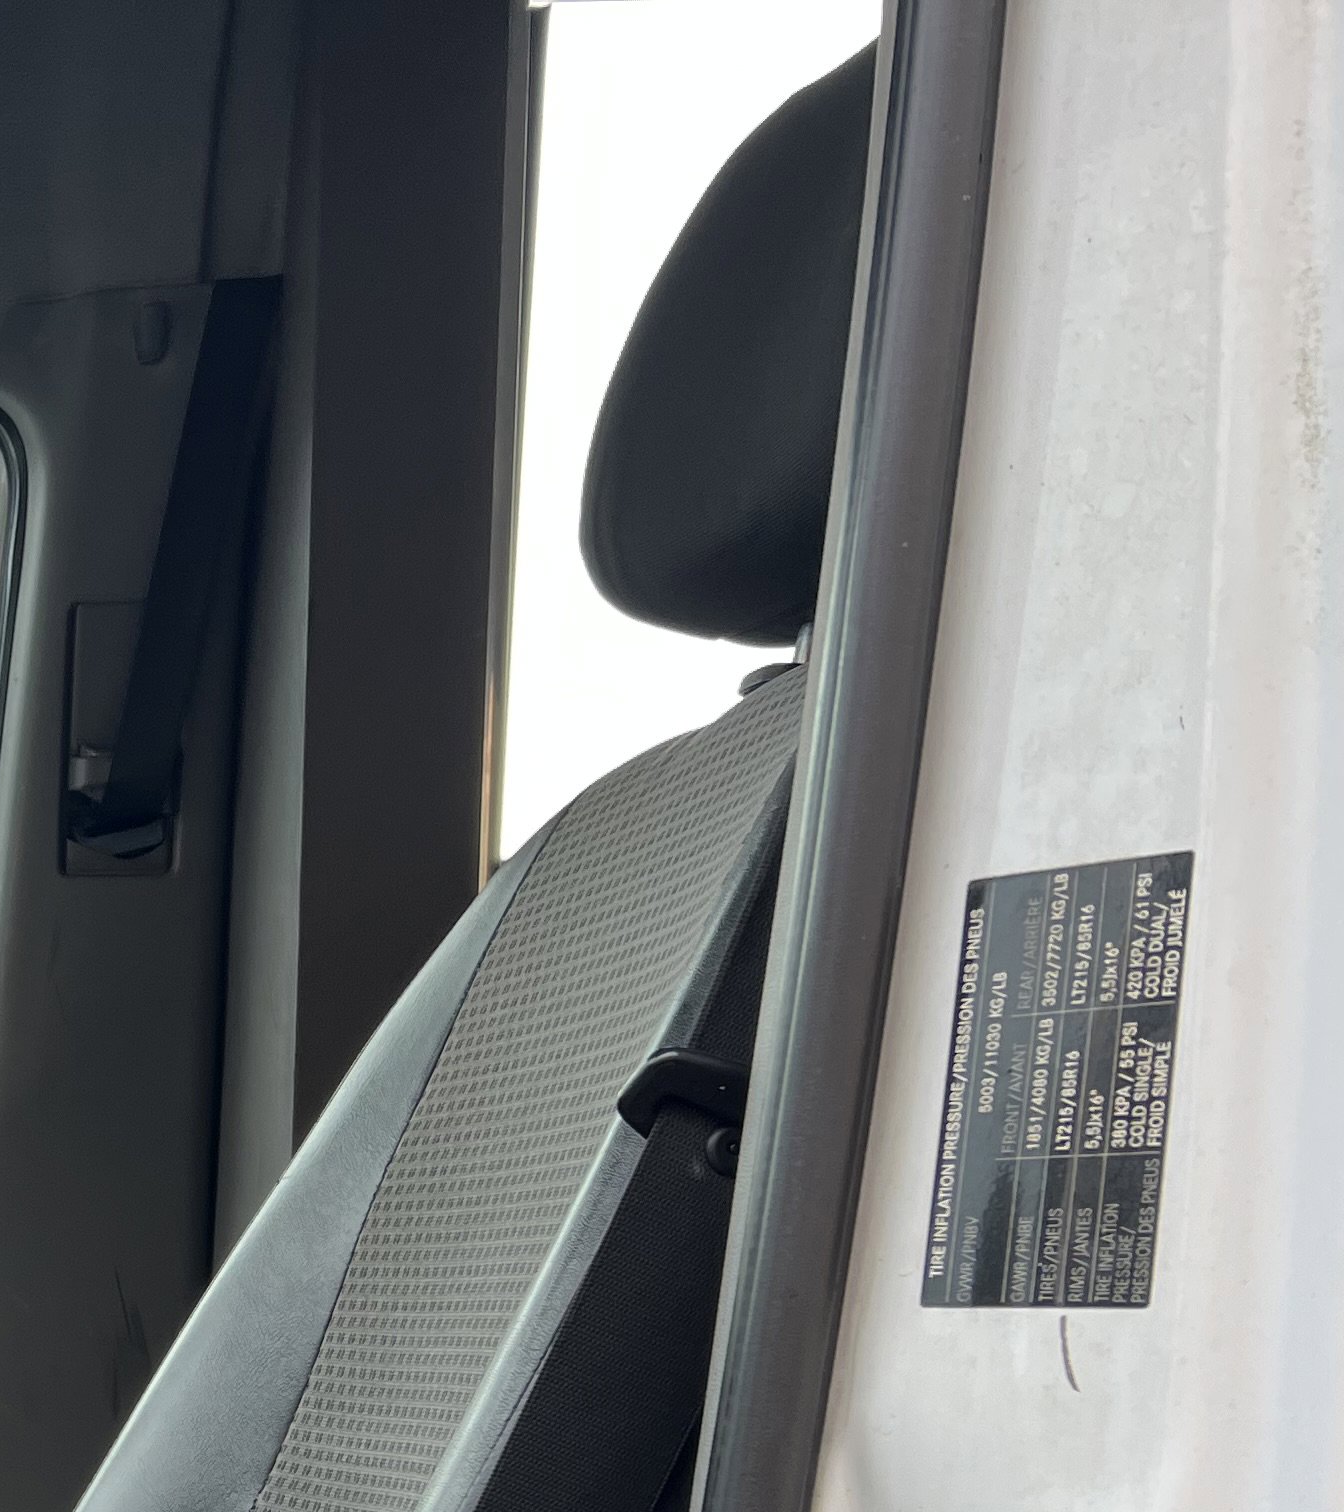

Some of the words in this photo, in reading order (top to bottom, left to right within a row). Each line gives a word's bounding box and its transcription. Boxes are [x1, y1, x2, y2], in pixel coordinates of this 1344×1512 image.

[1050, 872, 1069, 920] KG/LB
[1137, 872, 1153, 898] PSI
[966, 908, 985, 960] PNEUS
[1135, 901, 1150, 920] 61
[1148, 901, 1171, 955] DUAL/
[1165, 888, 1187, 947] JUMELÉ
[1042, 924, 1064, 1007] 3502/7720
[1130, 938, 1147, 968] KPA
[1162, 949, 1181, 997] FROID
[962, 963, 979, 993] DES
[989, 972, 1008, 1019] KG/LB
[1126, 971, 1144, 999] 420
[1144, 957, 1163, 998] COLD
[1034, 1018, 1055, 1064] KG/LB
[1121, 1021, 1139, 1047] PSI
[942, 998, 974, 1159] PRESSURE/PRESSION
[978, 1023, 1002, 1113] 5003/11030
[1119, 1051, 1135, 1069] 55
[1132, 1037, 1156, 1105] SINGLE/
[1151, 1040, 1172, 1098] SIMPLE
[1001, 1042, 1027, 1153] FRONT/AVANT
[1026, 1068, 1049, 1150] 1851/4080
[1037, 1207, 1064, 1302] TIRES/PNEUS
[1054, 1050, 1081, 1151] LT215/85R16
[1070, 904, 1095, 1005] LT215/85R16
[1113, 1087, 1131, 1117] KPA
[1110, 1118, 1129, 1149] 380
[1129, 1107, 1147, 1148] COLD
[1146, 1100, 1166, 1148] FROID
[933, 1162, 955, 1242] INFLATION
[1140, 1158, 1160, 1204] PNEUS
[1098, 1203, 1120, 1271] INFLATION
[1138, 1206, 1155, 1232] DES
[929, 1244, 948, 1278] TIRE
[1067, 1207, 1094, 1302] RIMS/JANTES
[1111, 1225, 1137, 1303] PRESSURE/
[1130, 1235, 1152, 1303] PRESSION
[1094, 1273, 1113, 1302] TIRE
